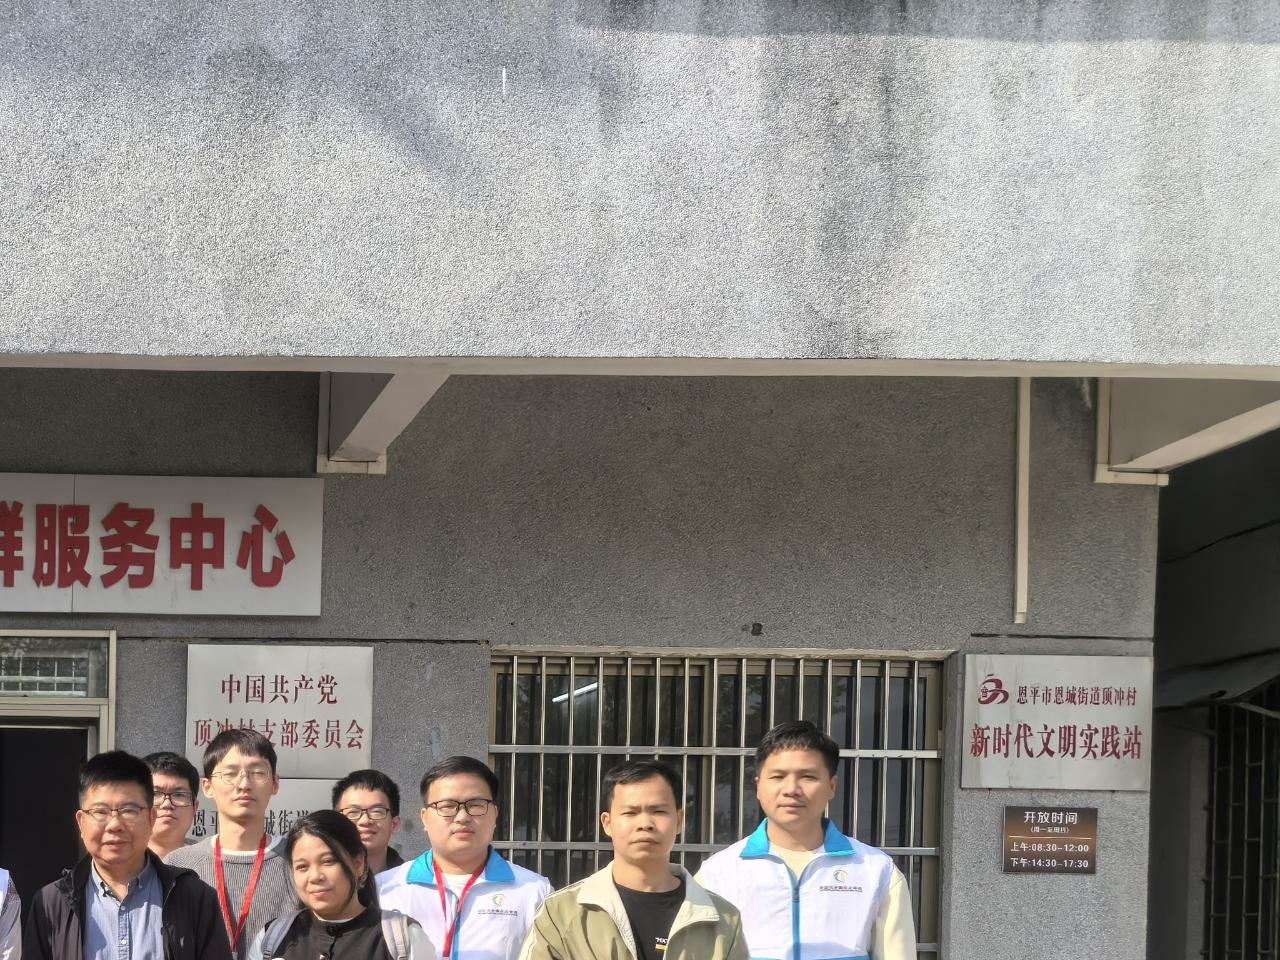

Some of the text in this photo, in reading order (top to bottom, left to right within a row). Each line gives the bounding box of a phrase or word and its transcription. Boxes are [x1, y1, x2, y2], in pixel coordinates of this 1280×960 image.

[220, 673, 339, 705] 中国共产党
[1016, 685, 1138, 706] 恩平市恩城街道顶冲村
[969, 722, 1143, 760] 新时代文明实践站
[1023, 811, 1079, 825] 开放时间
